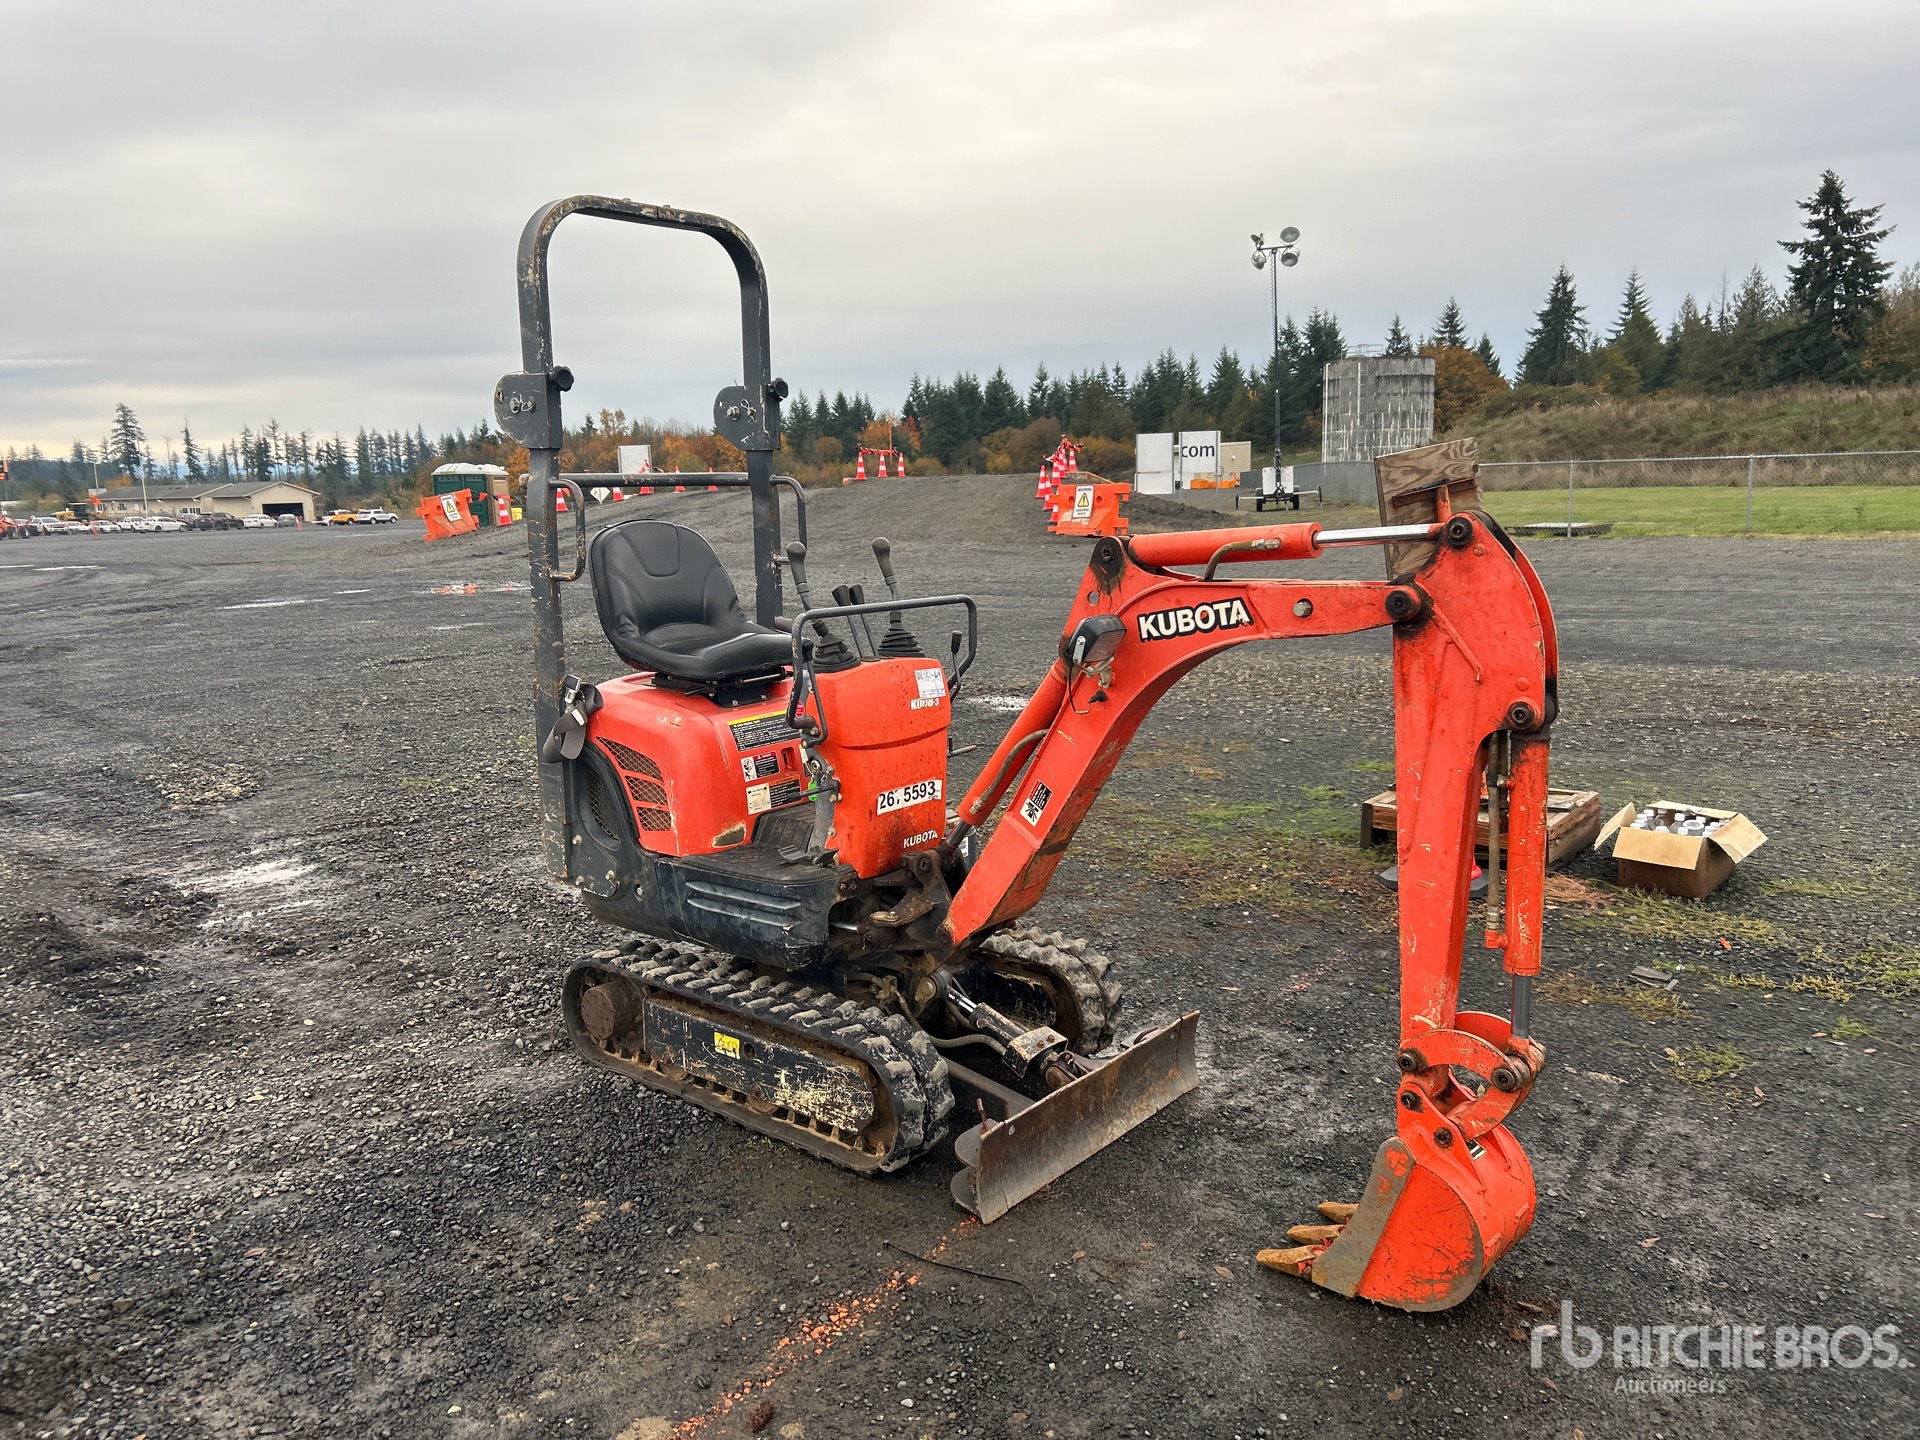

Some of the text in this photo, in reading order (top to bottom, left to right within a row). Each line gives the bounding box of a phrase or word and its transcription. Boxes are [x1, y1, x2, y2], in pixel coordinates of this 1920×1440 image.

[1181, 445, 1215, 457] com
[1138, 599, 1251, 640] KUBOTA
[903, 829, 938, 849] KUBOTA
